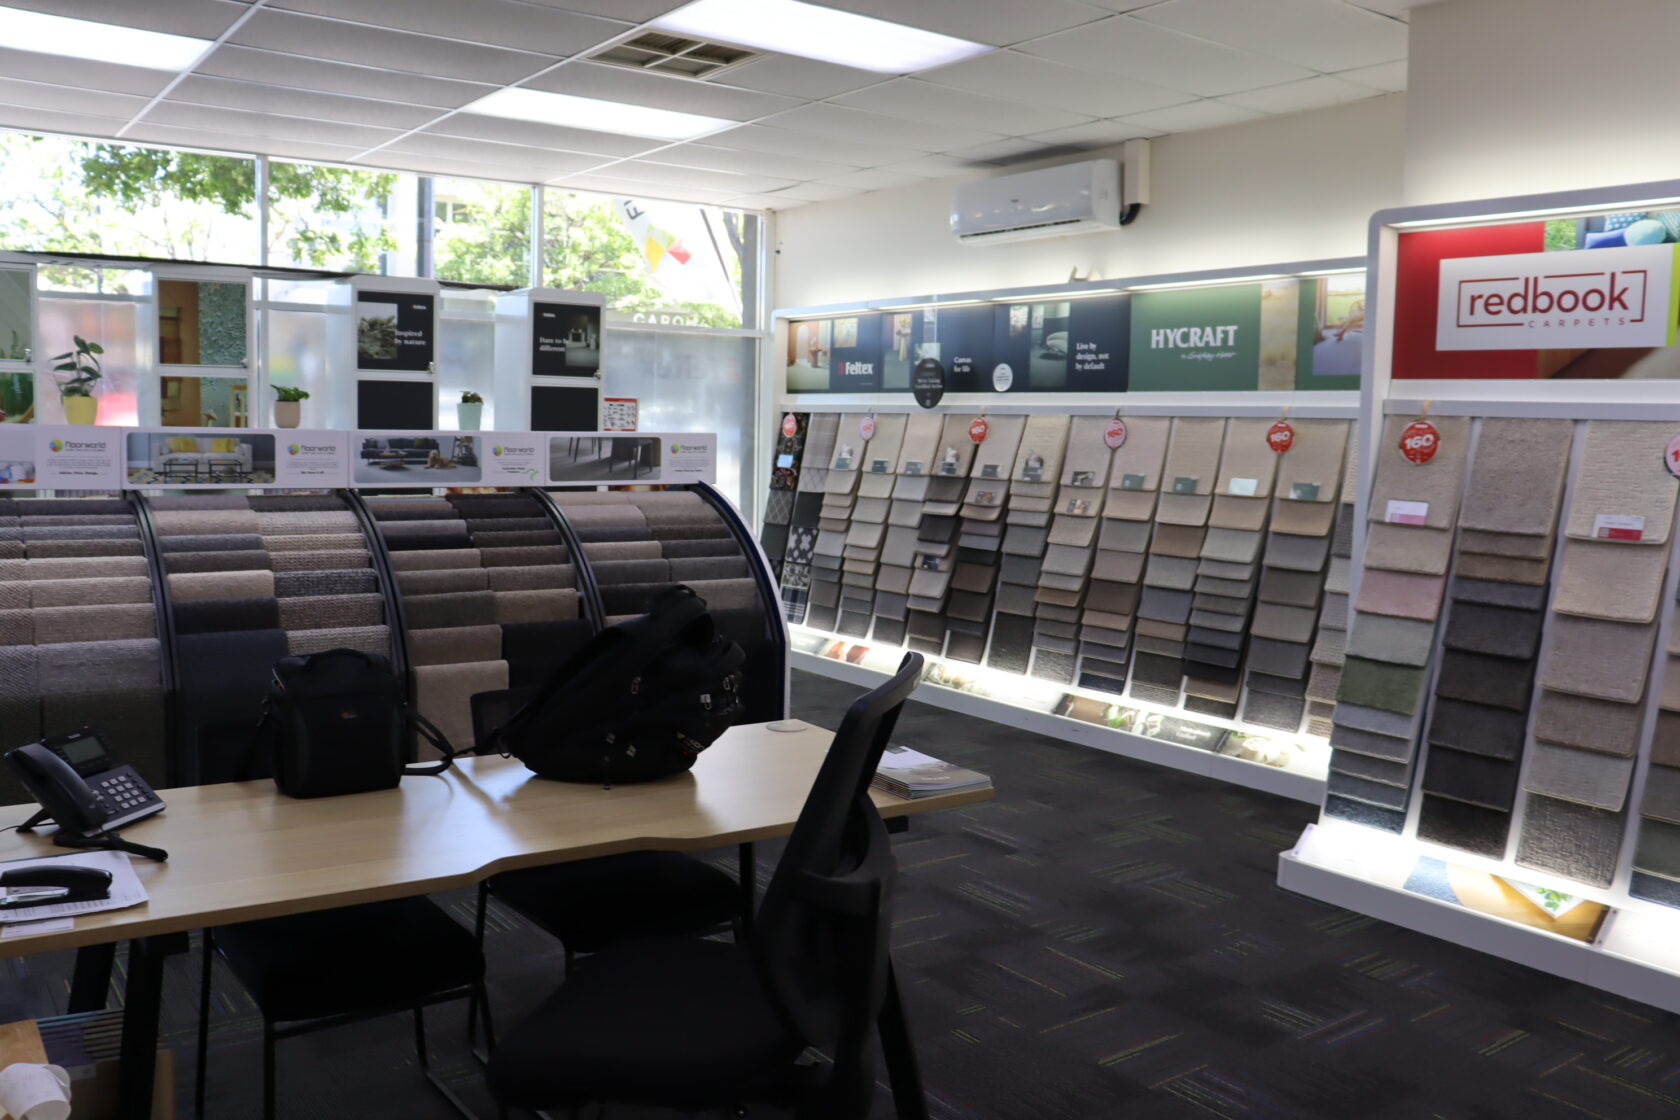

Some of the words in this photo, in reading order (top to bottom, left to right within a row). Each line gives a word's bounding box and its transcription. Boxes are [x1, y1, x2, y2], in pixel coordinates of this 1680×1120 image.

[1468, 271, 1630, 316] redbook
[1527, 317, 1627, 328] CARPETS
[1150, 325, 1238, 349] HYCRAFT
[845, 361, 874, 375] Feltex
[1270, 430, 1291, 442] 160
[1404, 433, 1435, 450] 160
